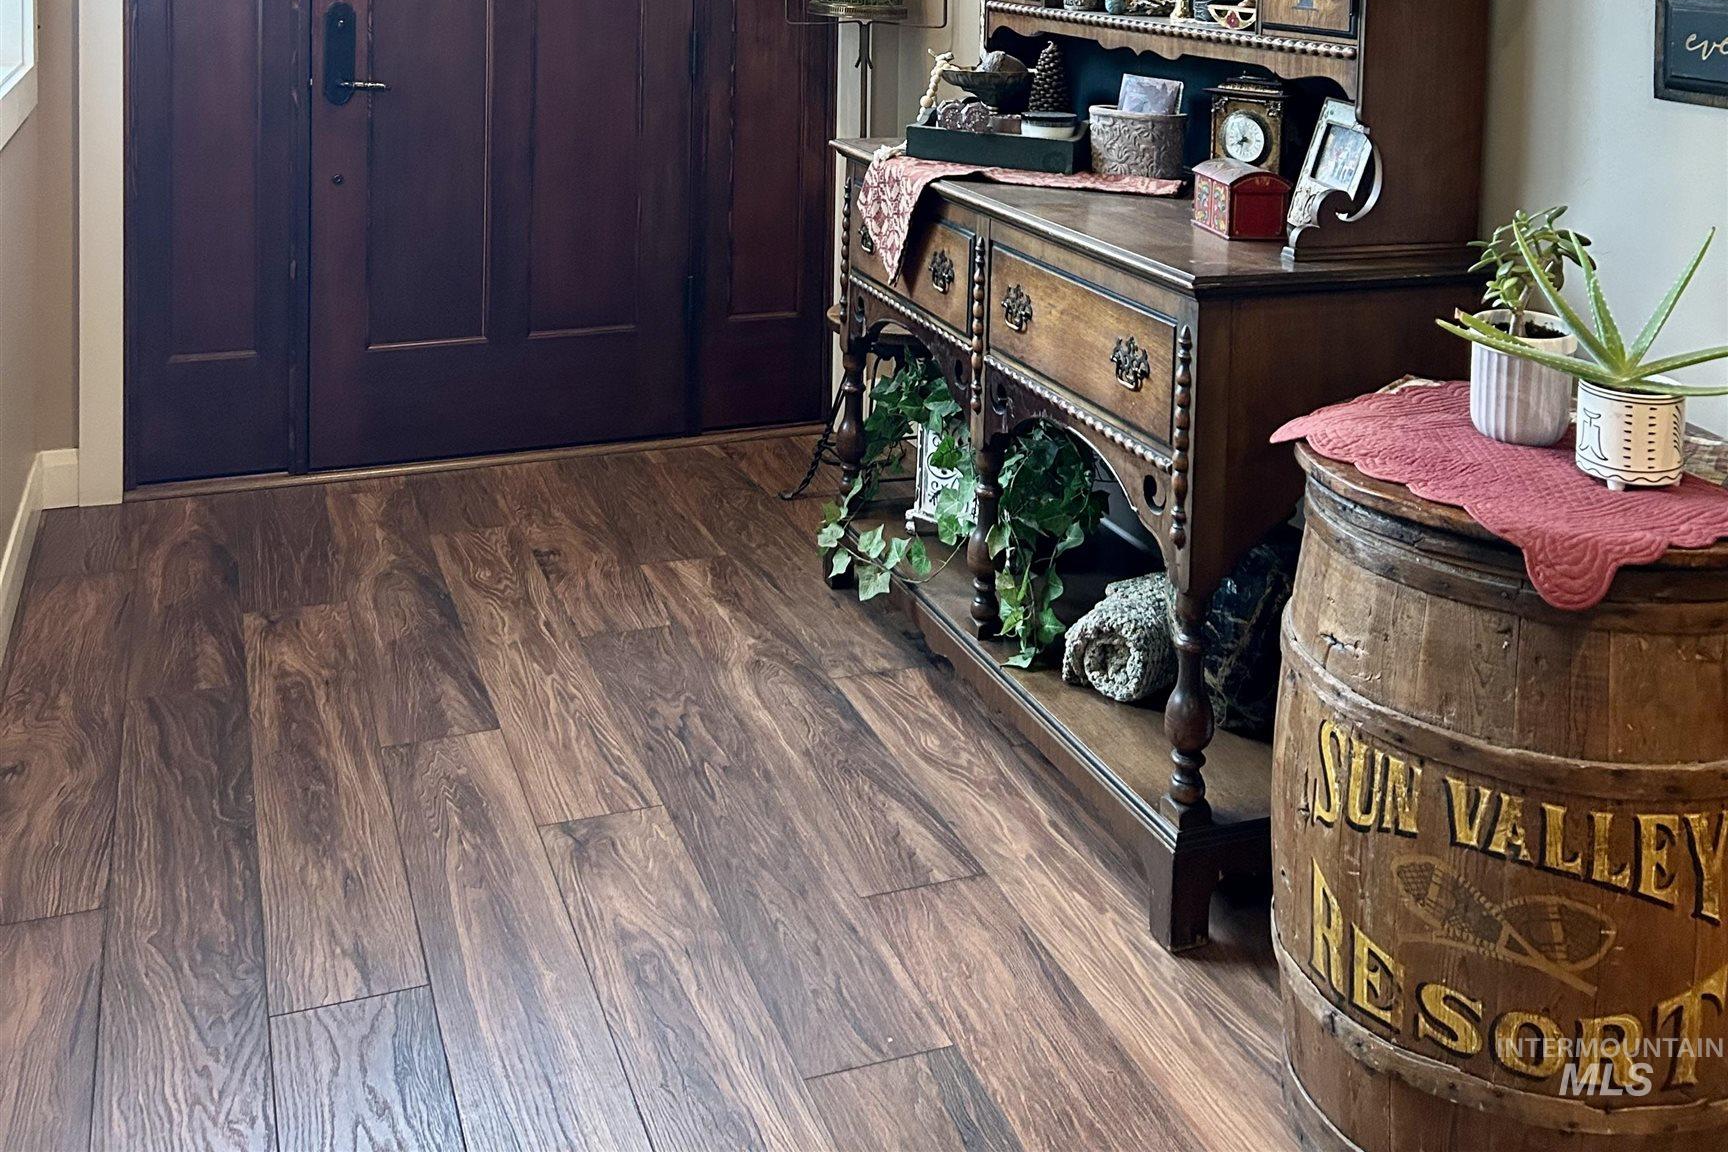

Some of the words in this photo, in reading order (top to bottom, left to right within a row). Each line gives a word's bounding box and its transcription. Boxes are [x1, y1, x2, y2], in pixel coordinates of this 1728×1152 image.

[1312, 719, 1423, 838] SUN
[1445, 774, 1728, 925] VALLEY
[1308, 857, 1728, 1091] RESORT
